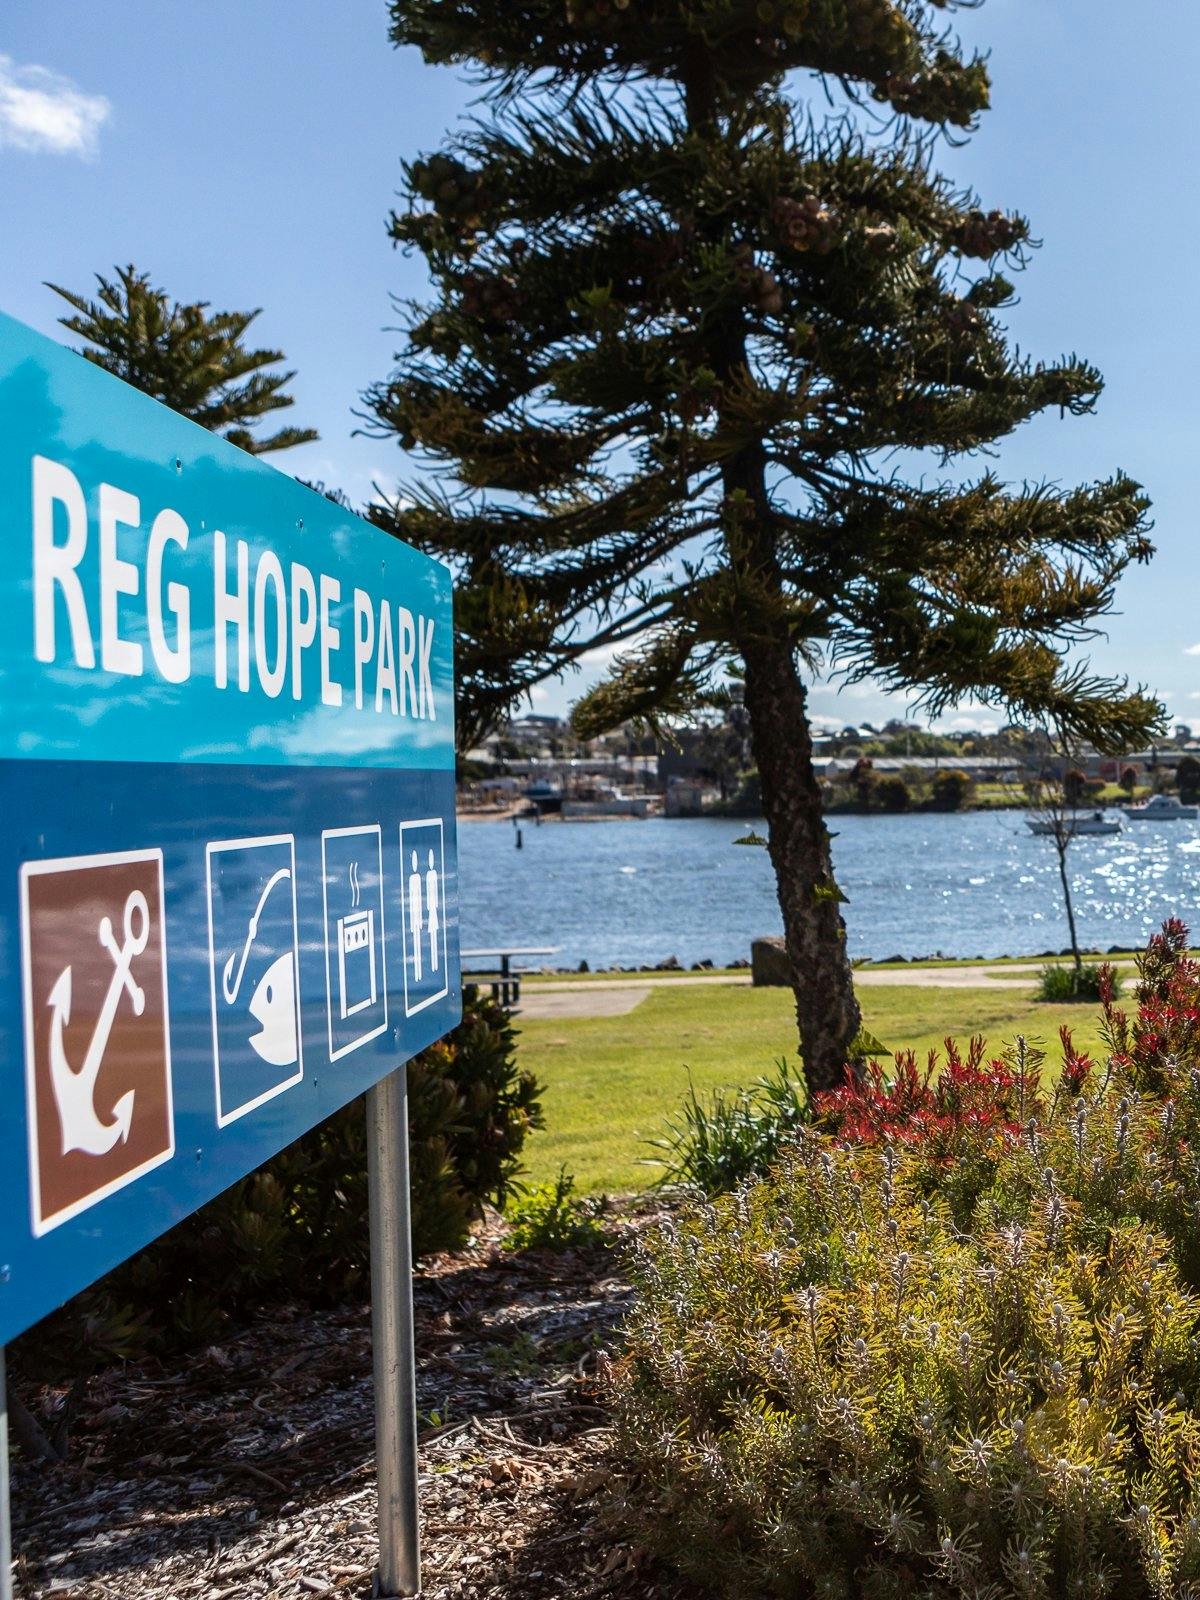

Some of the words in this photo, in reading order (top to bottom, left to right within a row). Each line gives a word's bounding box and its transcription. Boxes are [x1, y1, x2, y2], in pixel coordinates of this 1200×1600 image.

[32, 455, 191, 684] REG
[214, 530, 343, 706] HOPE
[354, 587, 436, 721] PARK
